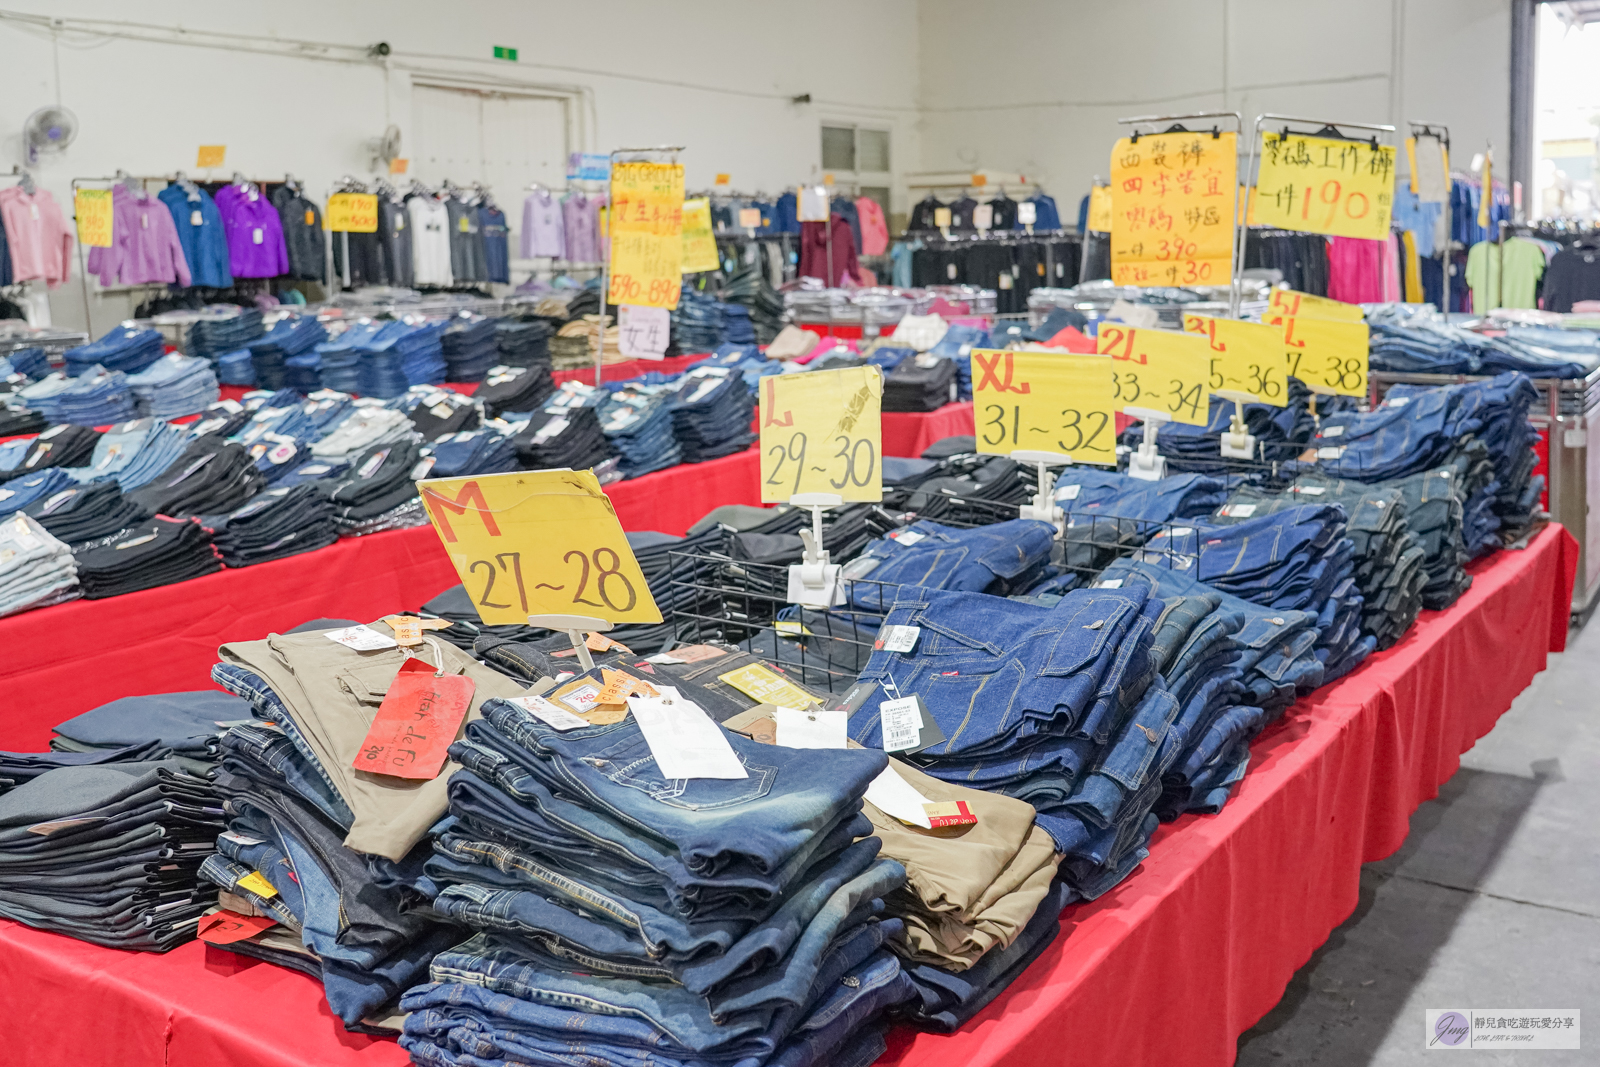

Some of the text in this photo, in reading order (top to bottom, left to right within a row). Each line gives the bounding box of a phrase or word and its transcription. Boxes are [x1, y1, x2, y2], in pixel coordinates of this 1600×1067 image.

[1156, 237, 1197, 261] 390
[1100, 328, 1147, 365] 2L
[974, 353, 1031, 394] XL
[1209, 358, 1281, 398] 5~36
[1287, 352, 1362, 390] 7~38
[764, 378, 794, 428] L
[982, 404, 1111, 452] 31~32
[766, 432, 875, 495] 29~30
[421, 481, 502, 543] M
[469, 547, 637, 614] 27~28
[602, 670, 632, 702] classic
